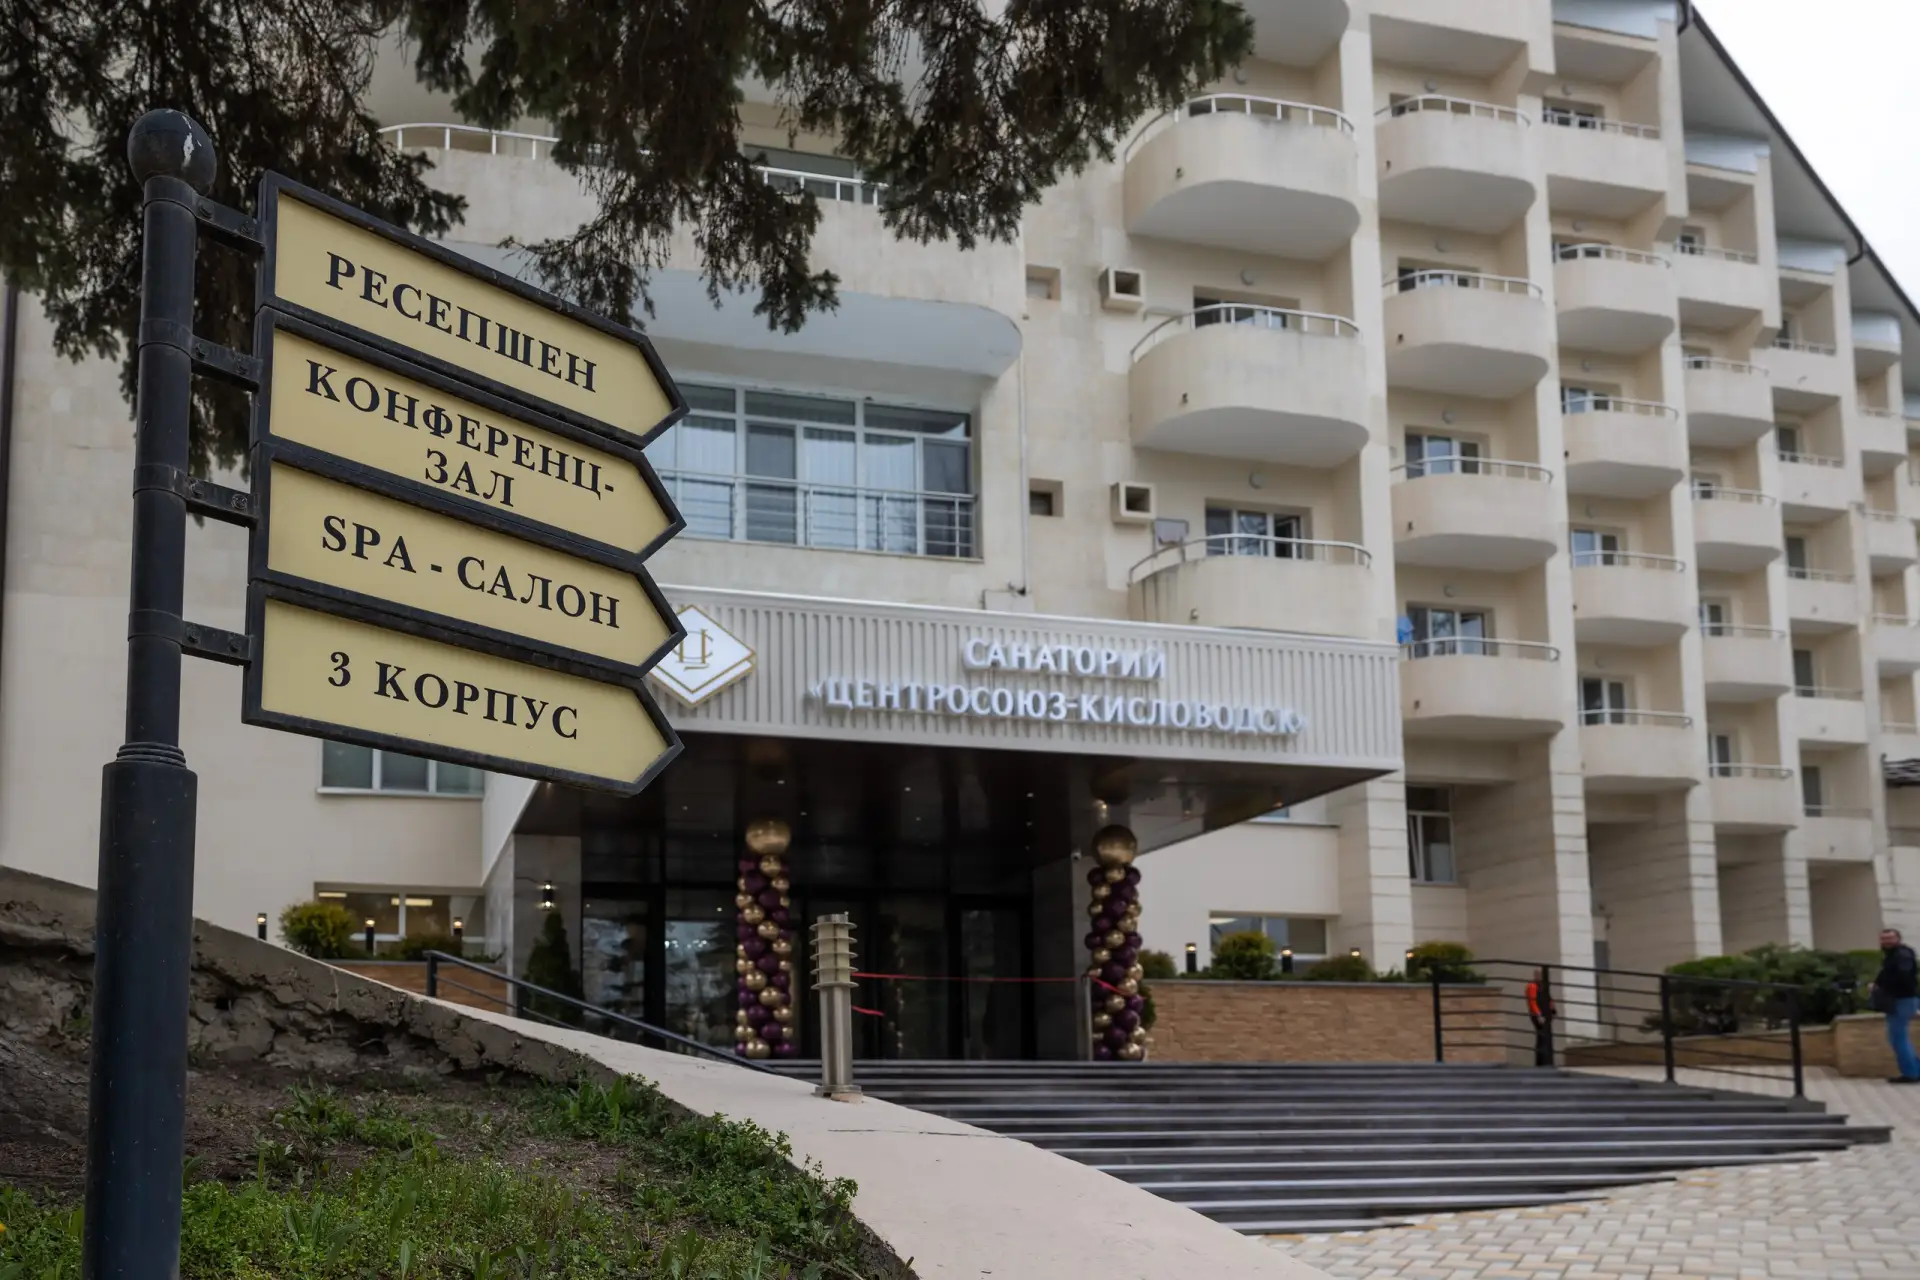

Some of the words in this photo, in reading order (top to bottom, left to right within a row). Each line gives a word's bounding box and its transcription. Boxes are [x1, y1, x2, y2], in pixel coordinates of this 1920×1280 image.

[326, 252, 596, 392] РЕСЕПШЕН
[306, 359, 614, 500] КОНФЕРЕНЦ-
[426, 449, 514, 507] ЗАЛ
[327, 651, 351, 688] 3
[374, 661, 578, 739] КОРПУС
[963, 637, 1166, 680] САНАТОРИЙ
